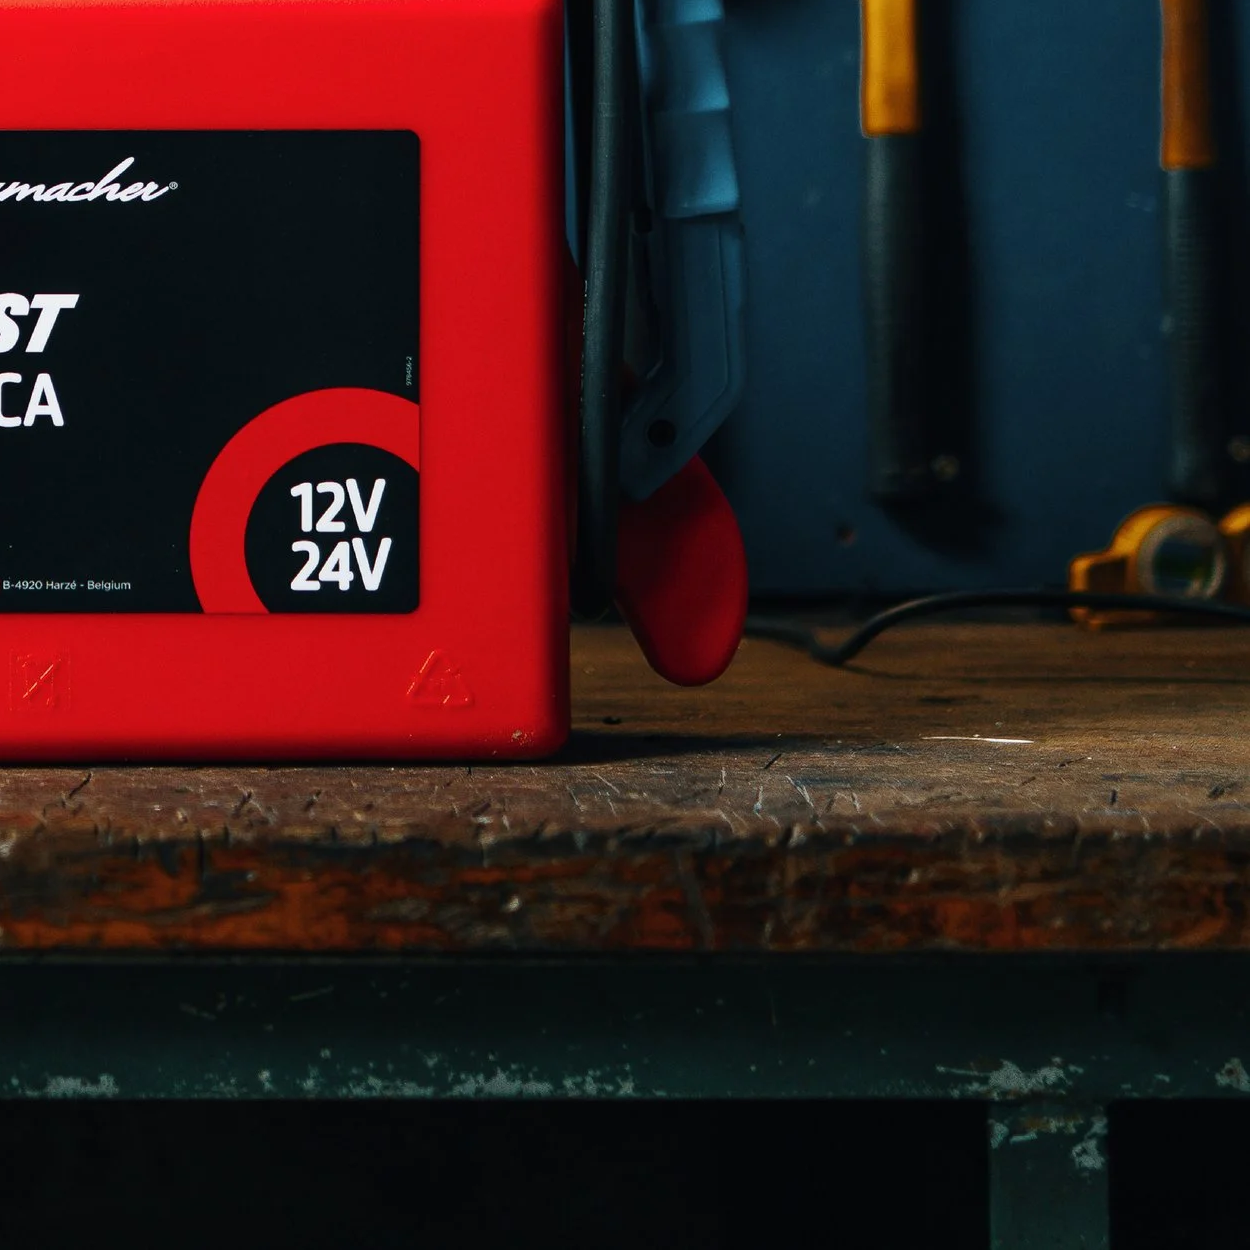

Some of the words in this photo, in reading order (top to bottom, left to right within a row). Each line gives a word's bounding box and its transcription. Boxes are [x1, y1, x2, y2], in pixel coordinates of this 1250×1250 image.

[290, 478, 387, 532] 12V
[2, 580, 43, 591] B-4920
[45, 579, 77, 591] Harzé
[87, 580, 131, 593] Belgium
[290, 537, 393, 591] 24V
